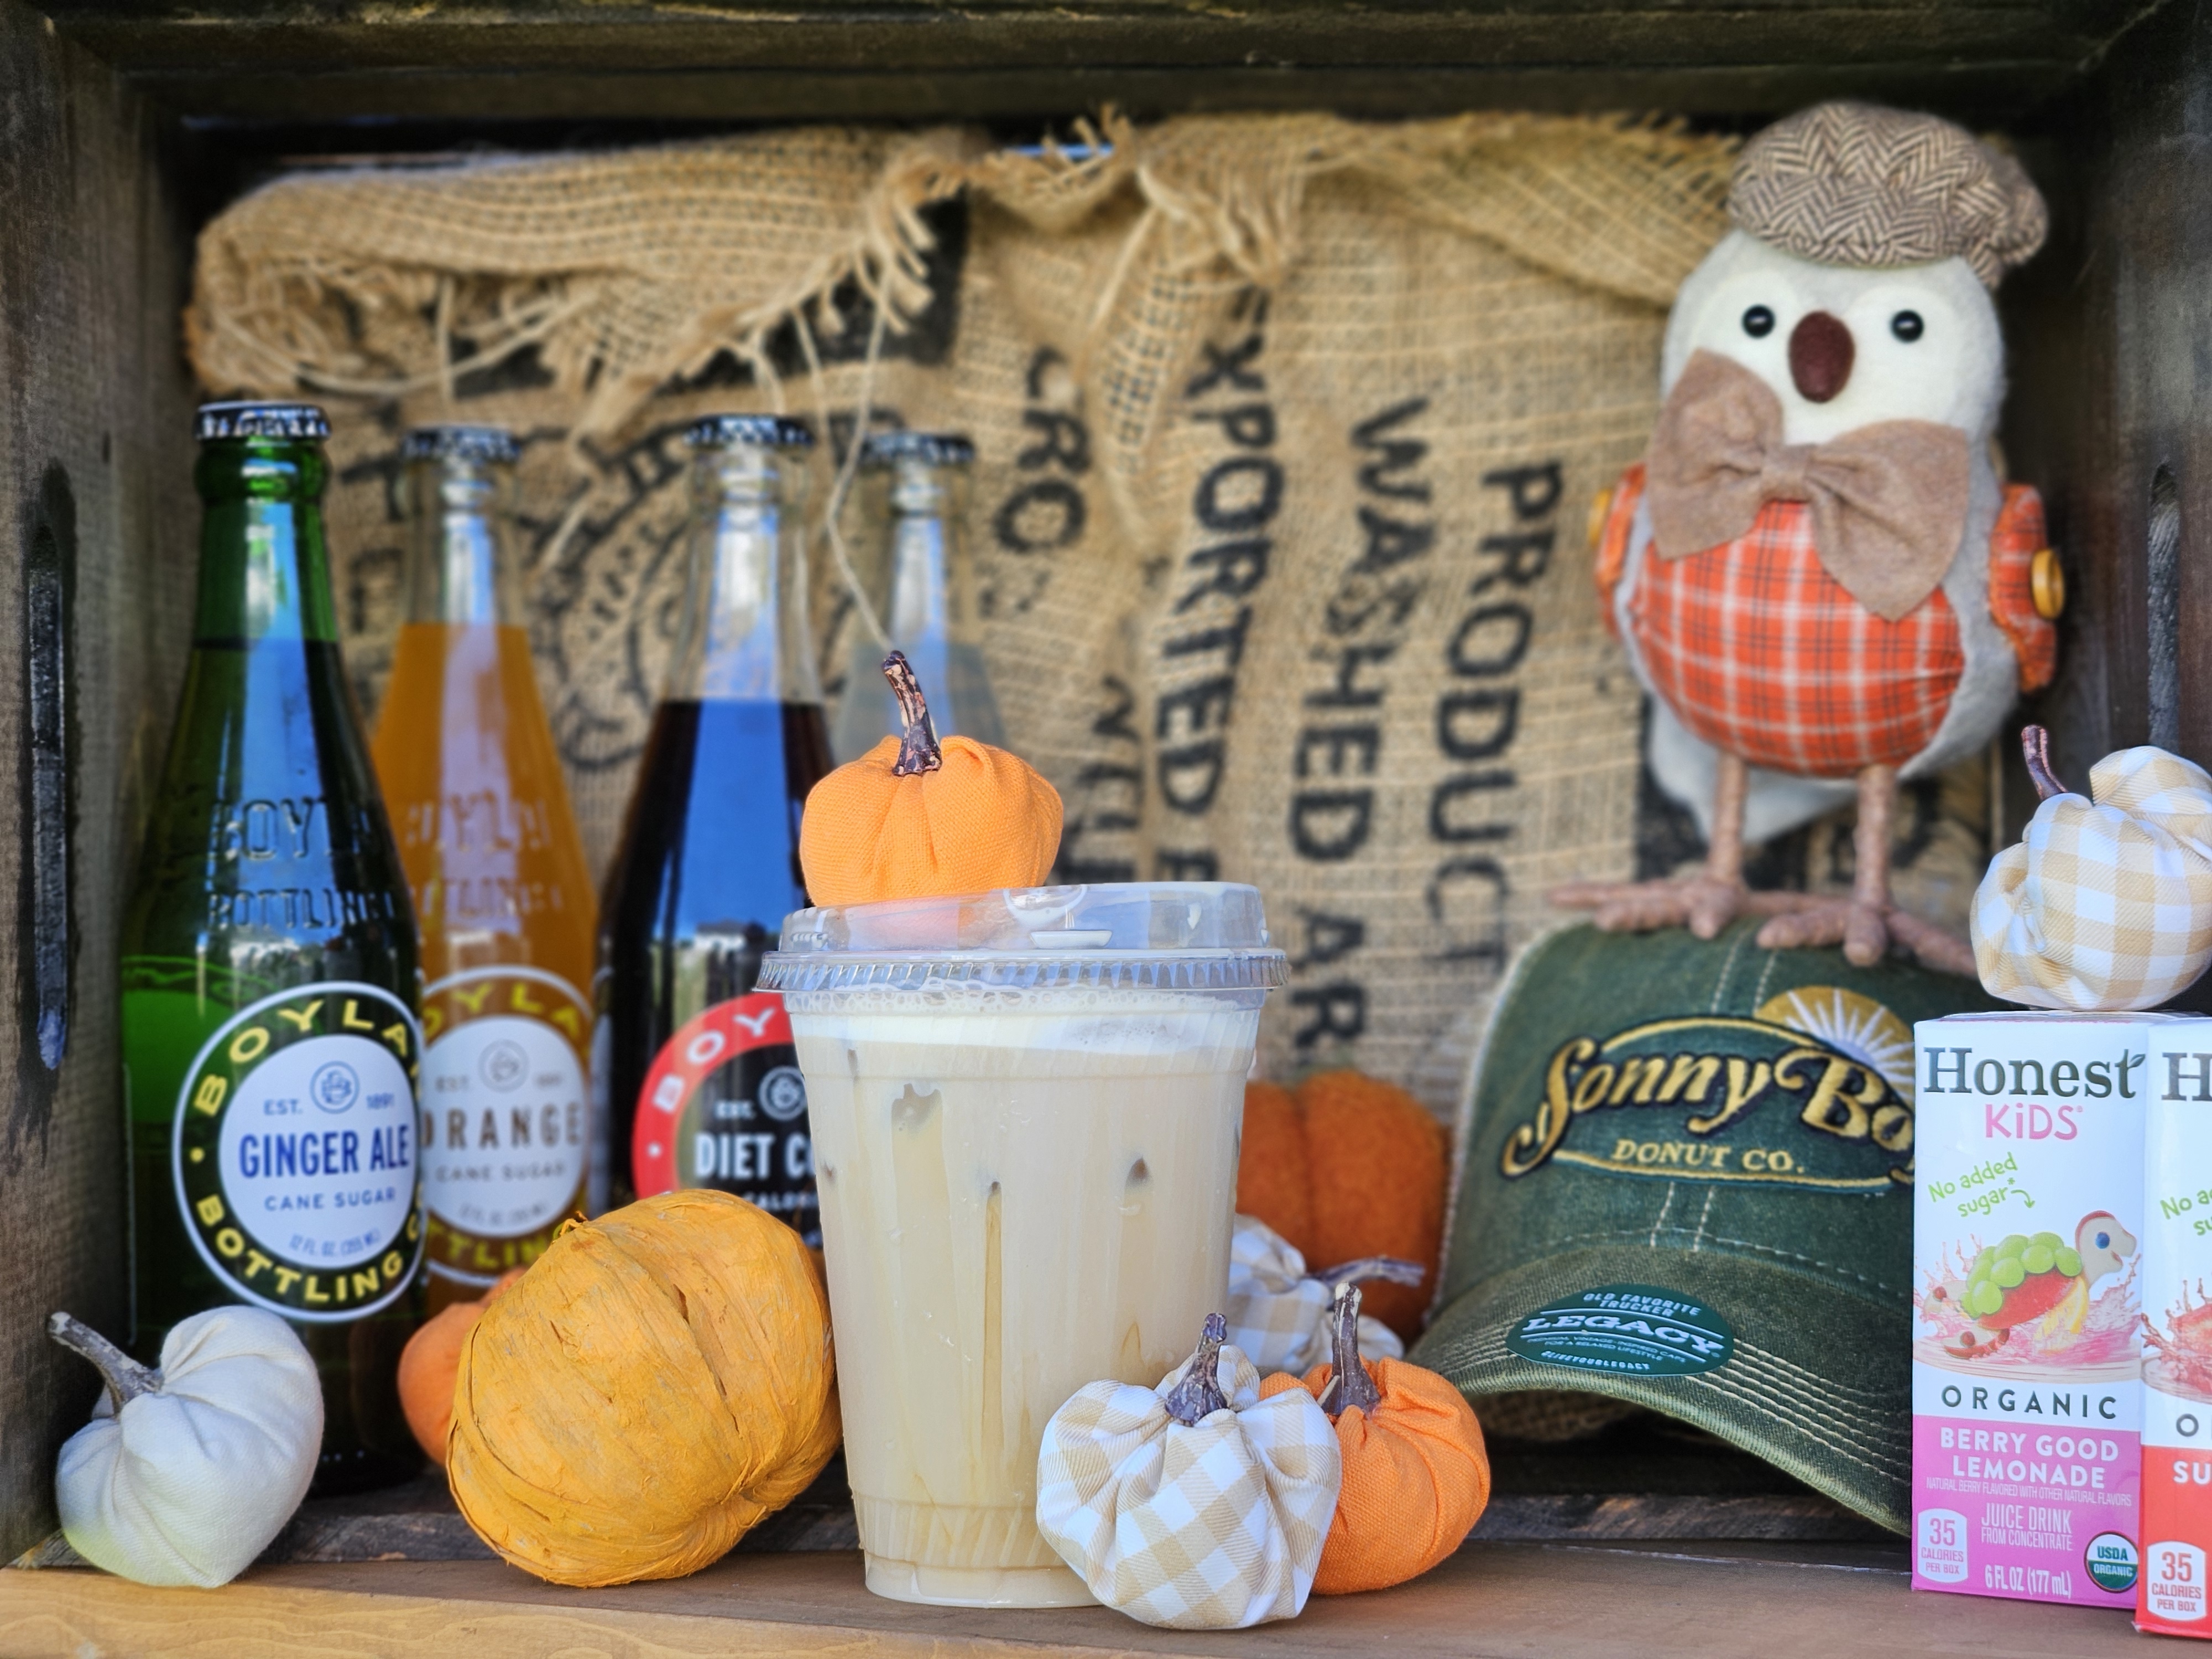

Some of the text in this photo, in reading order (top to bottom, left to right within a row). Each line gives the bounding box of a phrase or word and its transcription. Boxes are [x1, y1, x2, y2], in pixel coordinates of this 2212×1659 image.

[1290, 395, 1442, 864] WASHED
[1424, 459, 1564, 976] PRODUCT
[1923, 1046, 2146, 1099] Honest
[263, 1097, 304, 1116] EST.
[1500, 1035, 1914, 1179] Sonny Bo
[239, 1123, 410, 1179] GINGER ALE
[693, 1130, 776, 1180] DIET
[1612, 1138, 1804, 1173] DONUT CO.
[1928, 1151, 2018, 1203] No added
[263, 1187, 397, 1212] CANE SUGAR
[2160, 1196, 2192, 1220] No
[196, 1193, 404, 1303] BOTTLING
[1583, 1292, 1702, 1317] OLD FAVORITE
[1599, 1300, 1675, 1317] TRUCKER
[1521, 1314, 1725, 1354] LEGACY
[1941, 1385, 2117, 1420] ORGANIC
[1940, 1427, 2119, 1462] BERRY GOOD
[1953, 1455, 2105, 1489] LEMONADE
[1926, 1477, 2132, 1507] NATURAL BERRY FLAVORED WITH OTHER NATURAL FLAVORS
[1928, 1518, 1956, 1546] 35
[1981, 1502, 2073, 1534] JUICE DRINK
[1921, 1547, 1964, 1563] CALORIES
[1981, 1527, 2073, 1552] FROM CONCENTRATE
[2097, 1545, 2129, 1561] USDA
[1925, 1562, 1960, 1575] PER BOX
[1984, 1564, 2072, 1599] 6 FL OZ (177 mL)
[2093, 1562, 2133, 1578] ORGANIC
[2161, 1551, 2193, 1582] 35
[2151, 1583, 2202, 1600] CALORIES
[2157, 1598, 2197, 1613] PER BOX
